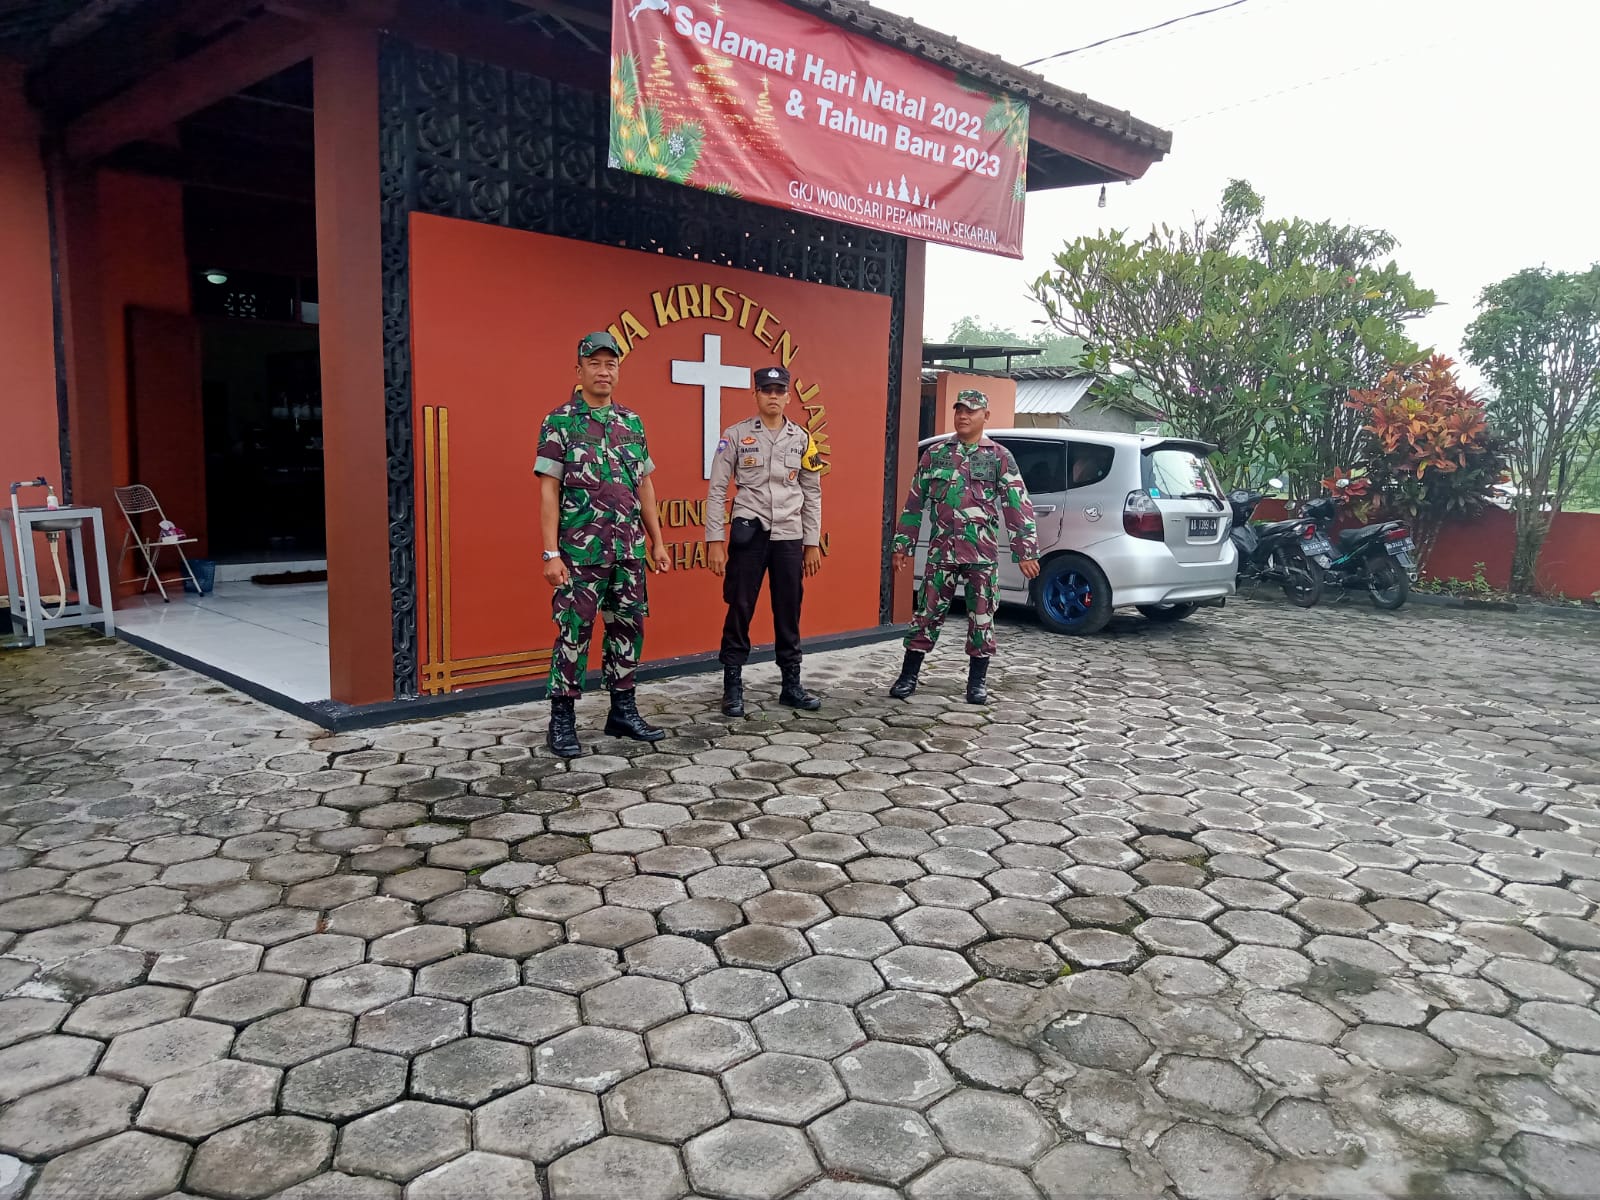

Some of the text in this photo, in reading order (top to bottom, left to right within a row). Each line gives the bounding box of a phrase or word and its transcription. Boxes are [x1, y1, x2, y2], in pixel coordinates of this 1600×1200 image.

[674, 5, 982, 140] Selamat Hari Natal 2022
[785, 89, 1000, 177] & Tahun Baru 2023
[788, 180, 998, 245] GKJ WONOSARI PEPANTHAN SEKARAN
[652, 283, 800, 369] KRISTEN
